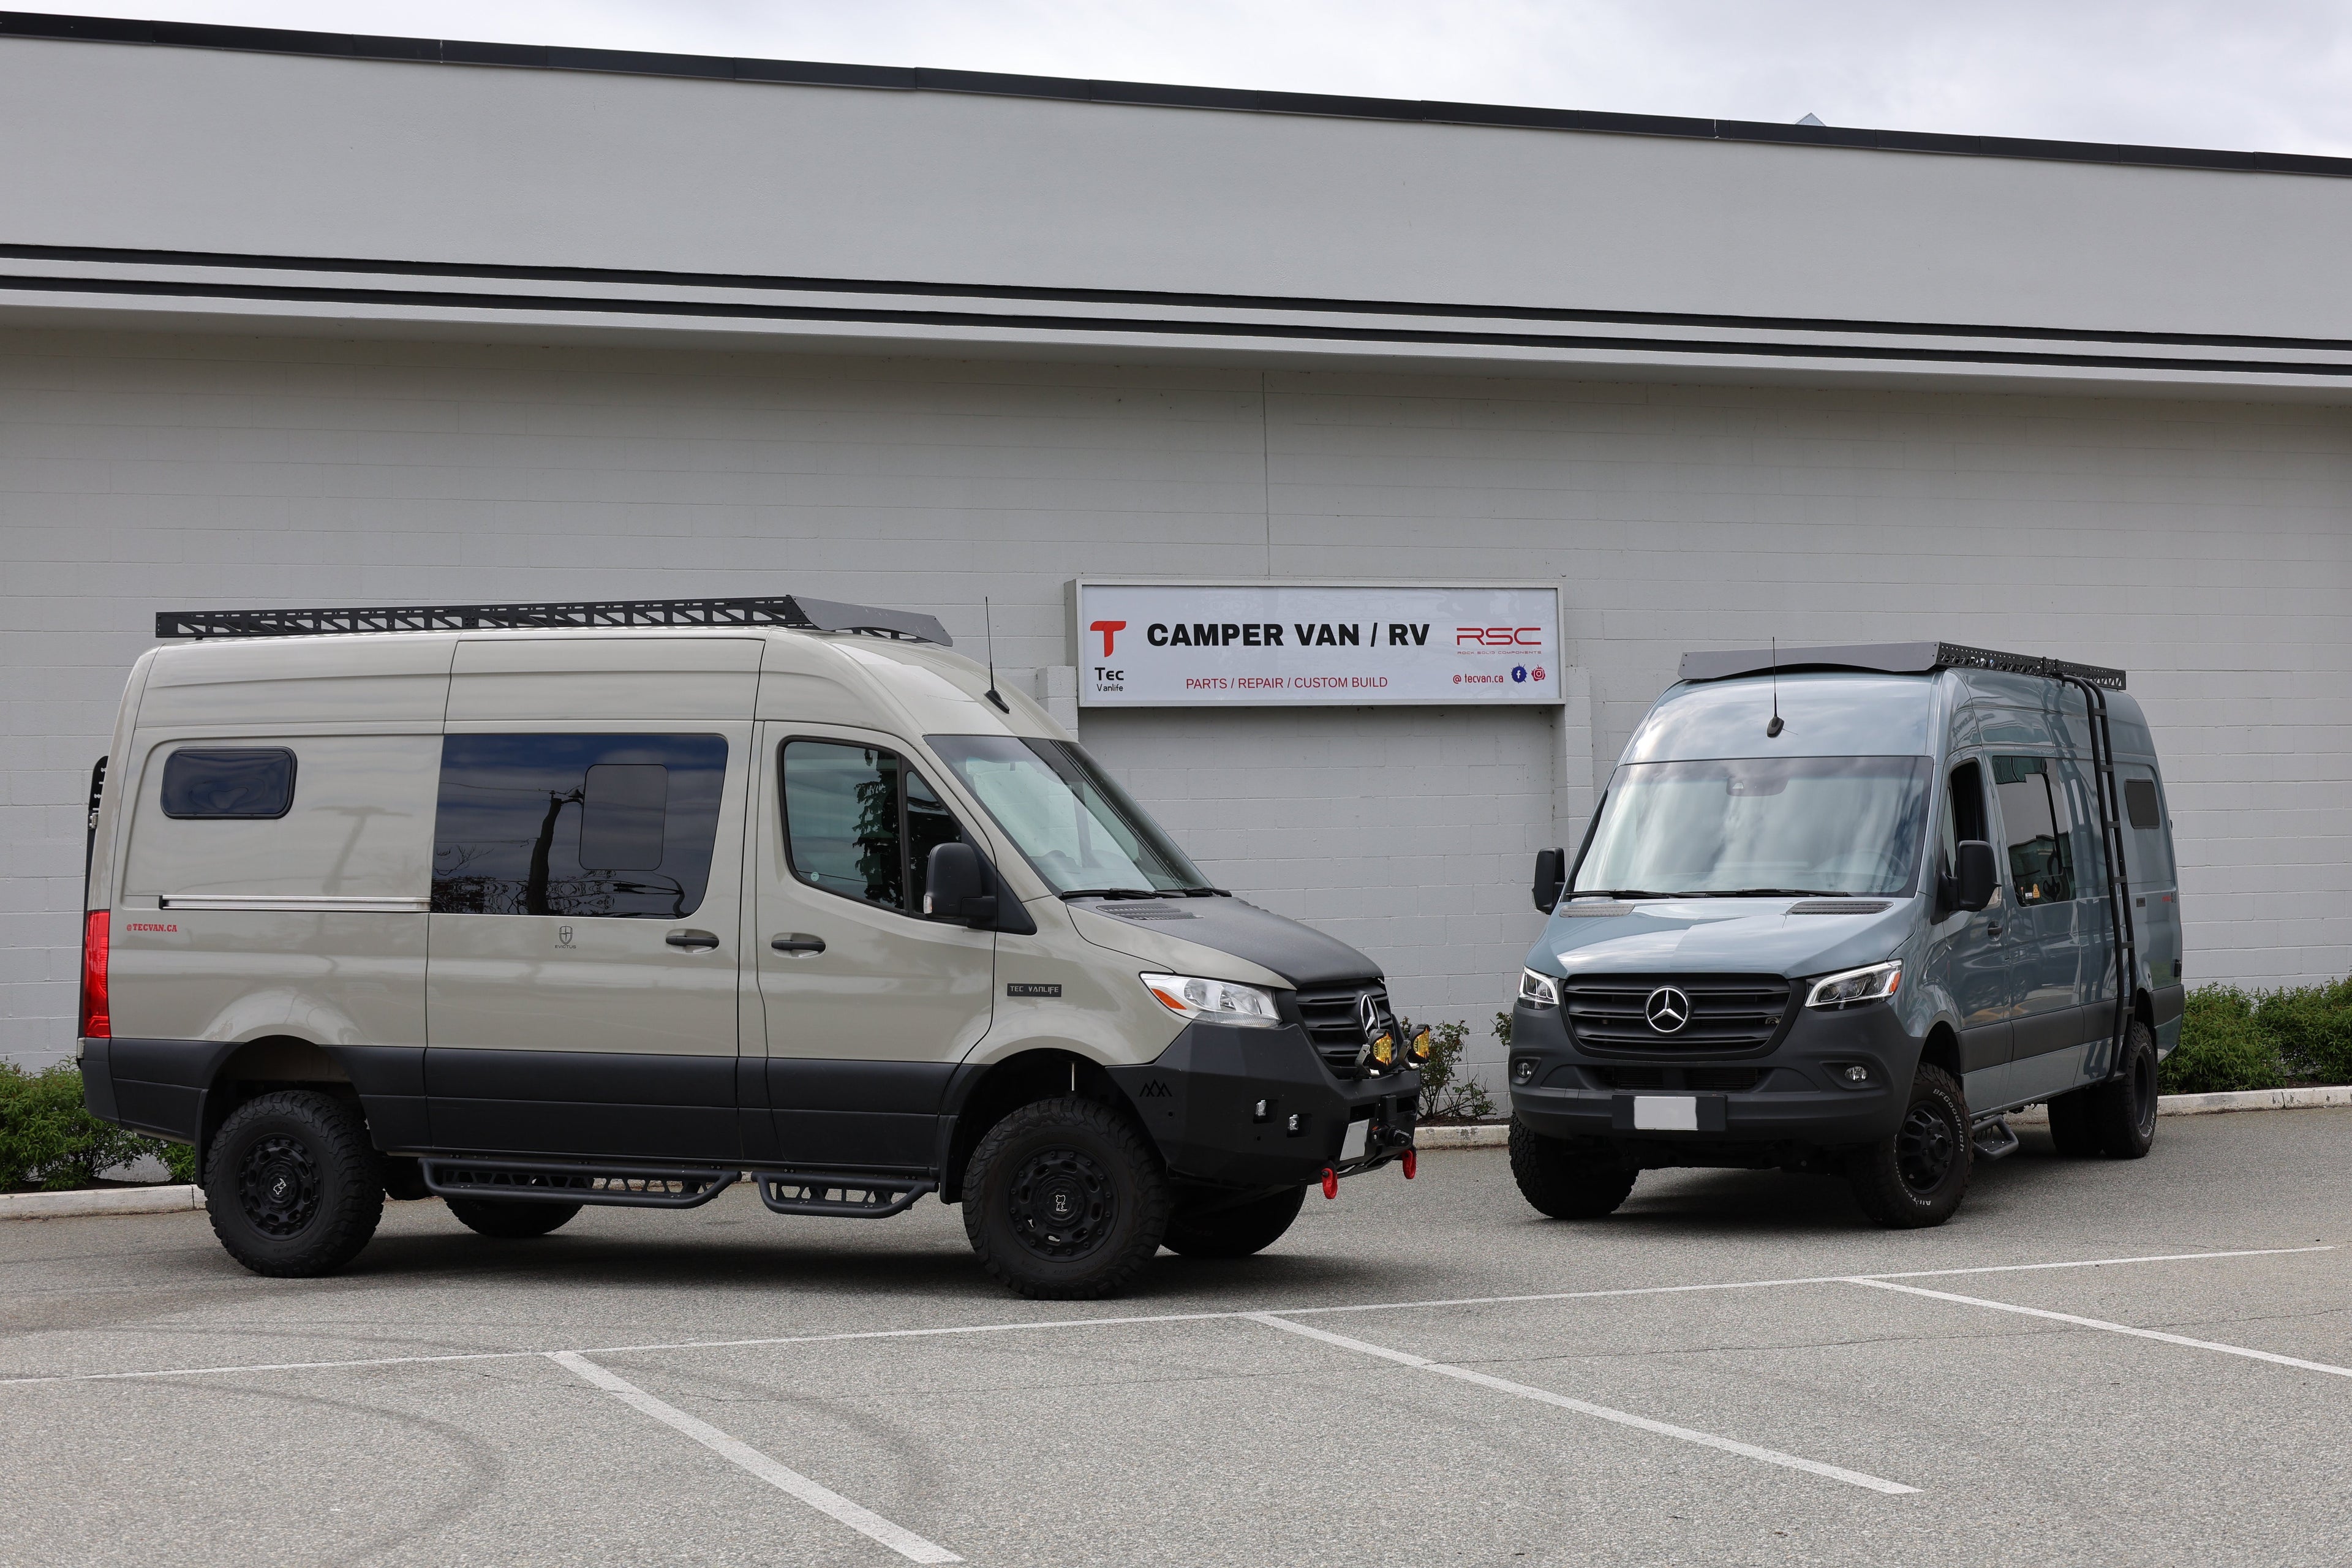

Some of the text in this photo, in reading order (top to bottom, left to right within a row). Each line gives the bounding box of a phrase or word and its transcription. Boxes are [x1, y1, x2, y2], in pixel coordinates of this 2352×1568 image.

[1147, 622, 1430, 647] CAMPER VAN / RV
[1456, 627, 1542, 646] RSC
[1186, 676, 1388, 690] PARTS / REPAIR / CUSTOM BUILD
[1452, 673, 1504, 684] @ tecvan.ca
[1096, 683, 1124, 692] Vanlife
[126, 923, 178, 932] @TECVAN.CA
[1028, 986, 1059, 994] VANLIFE
[1933, 1088, 1964, 1152] BFGoodrich
